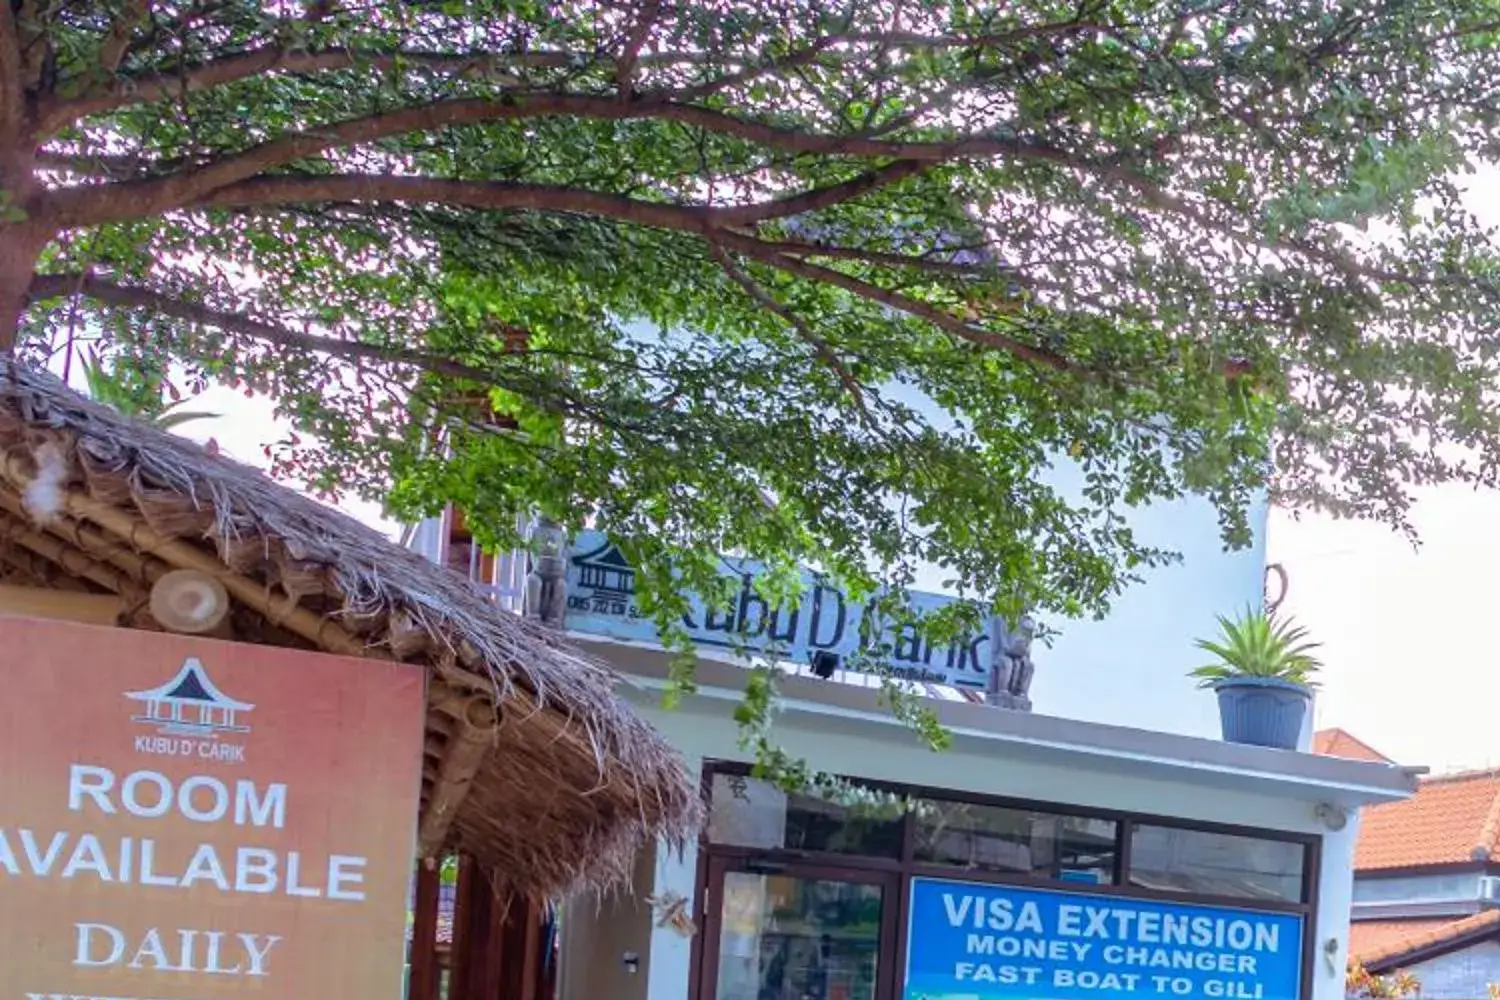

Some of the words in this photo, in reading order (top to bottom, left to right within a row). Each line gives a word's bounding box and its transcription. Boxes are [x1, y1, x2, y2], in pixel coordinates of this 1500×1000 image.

[135, 736, 177, 755] KUBU
[198, 740, 245, 761] CARIK
[69, 764, 287, 828] ROOM
[943, 893, 1043, 934] VISA
[1059, 904, 1279, 953] EXTENSION
[74, 923, 282, 976] DAILY
[967, 934, 1092, 962] MONEY
[1103, 945, 1256, 975] CHANGER
[955, 962, 1042, 986] FAST
[1054, 970, 1141, 991] BOAT
[1152, 976, 1192, 995] TO
[1203, 980, 1263, 999] GILI
